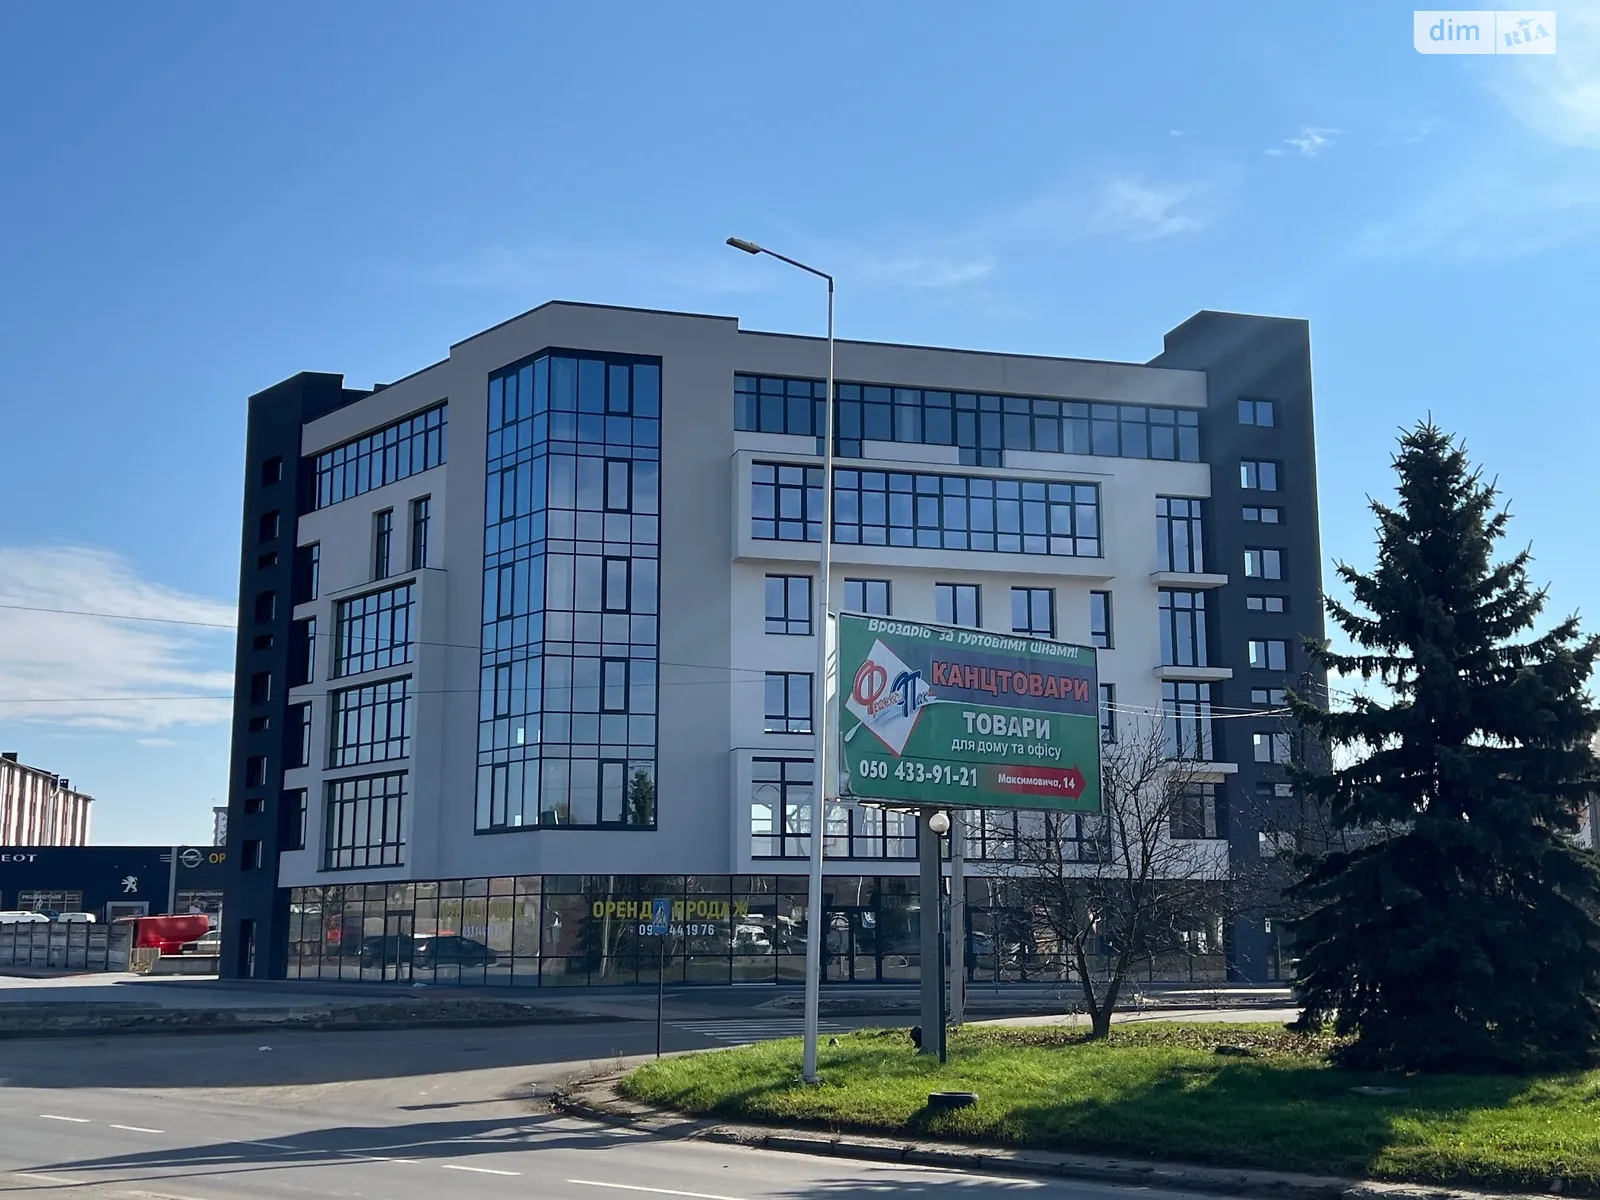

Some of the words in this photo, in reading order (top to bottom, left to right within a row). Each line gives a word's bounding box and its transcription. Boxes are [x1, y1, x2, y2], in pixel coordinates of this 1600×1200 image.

[939, 628, 954, 642] за
[931, 660, 1089, 702] КАНЦТОВАРИ
[962, 711, 1050, 740] ТОВАРИ
[951, 738, 975, 752] для
[977, 742, 1008, 756] дому
[1011, 743, 1024, 755] та
[1027, 743, 1062, 760] офісу
[859, 760, 888, 779] 050
[894, 761, 978, 787] 433-91-21
[998, 773, 1062, 790] Максимовича,
[1063, 777, 1076, 789] 14
[1, 854, 37, 862] EOT
[592, 901, 654, 919] ОРЕНД
